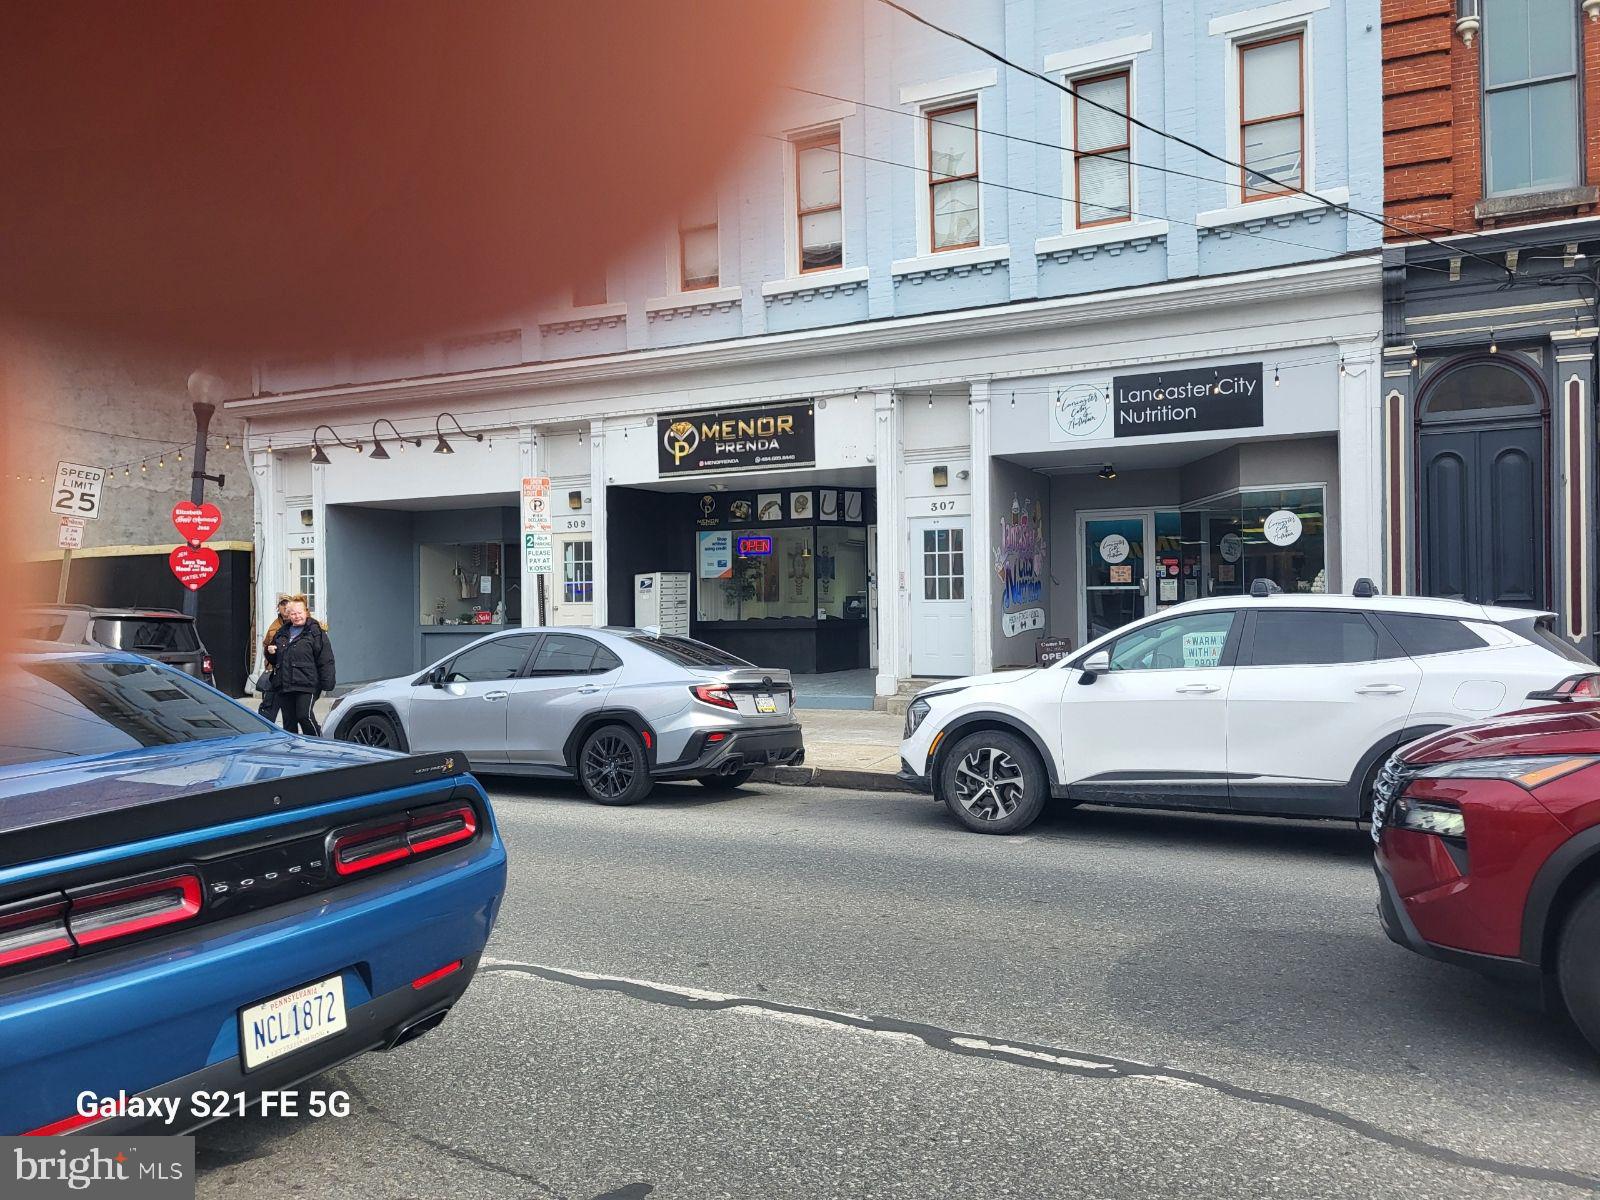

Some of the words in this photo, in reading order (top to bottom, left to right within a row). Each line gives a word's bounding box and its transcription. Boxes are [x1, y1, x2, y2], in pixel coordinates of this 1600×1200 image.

[1120, 384, 1212, 404] Lancaster
[1216, 378, 1257, 396] City
[1120, 405, 1197, 424] Nutrition
[702, 416, 794, 442] MENOR
[716, 439, 780, 454] PRENDA
[60, 468, 100, 481] SPEED
[63, 479, 94, 490] LIMIT
[56, 490, 96, 512] 25
[931, 501, 955, 511] 307
[567, 520, 586, 528] 309
[526, 536, 534, 546] 2
[740, 540, 770, 552] OPEN
[1192, 636, 1216, 645] WARM
[1042, 652, 1069, 661] OPEN
[1189, 648, 1208, 657] WITH
[1212, 648, 1216, 656] A
[214, 860, 322, 893] DODGE
[270, 987, 318, 1011] PENNSYLVANIA
[253, 992, 336, 1050] NCL1872
